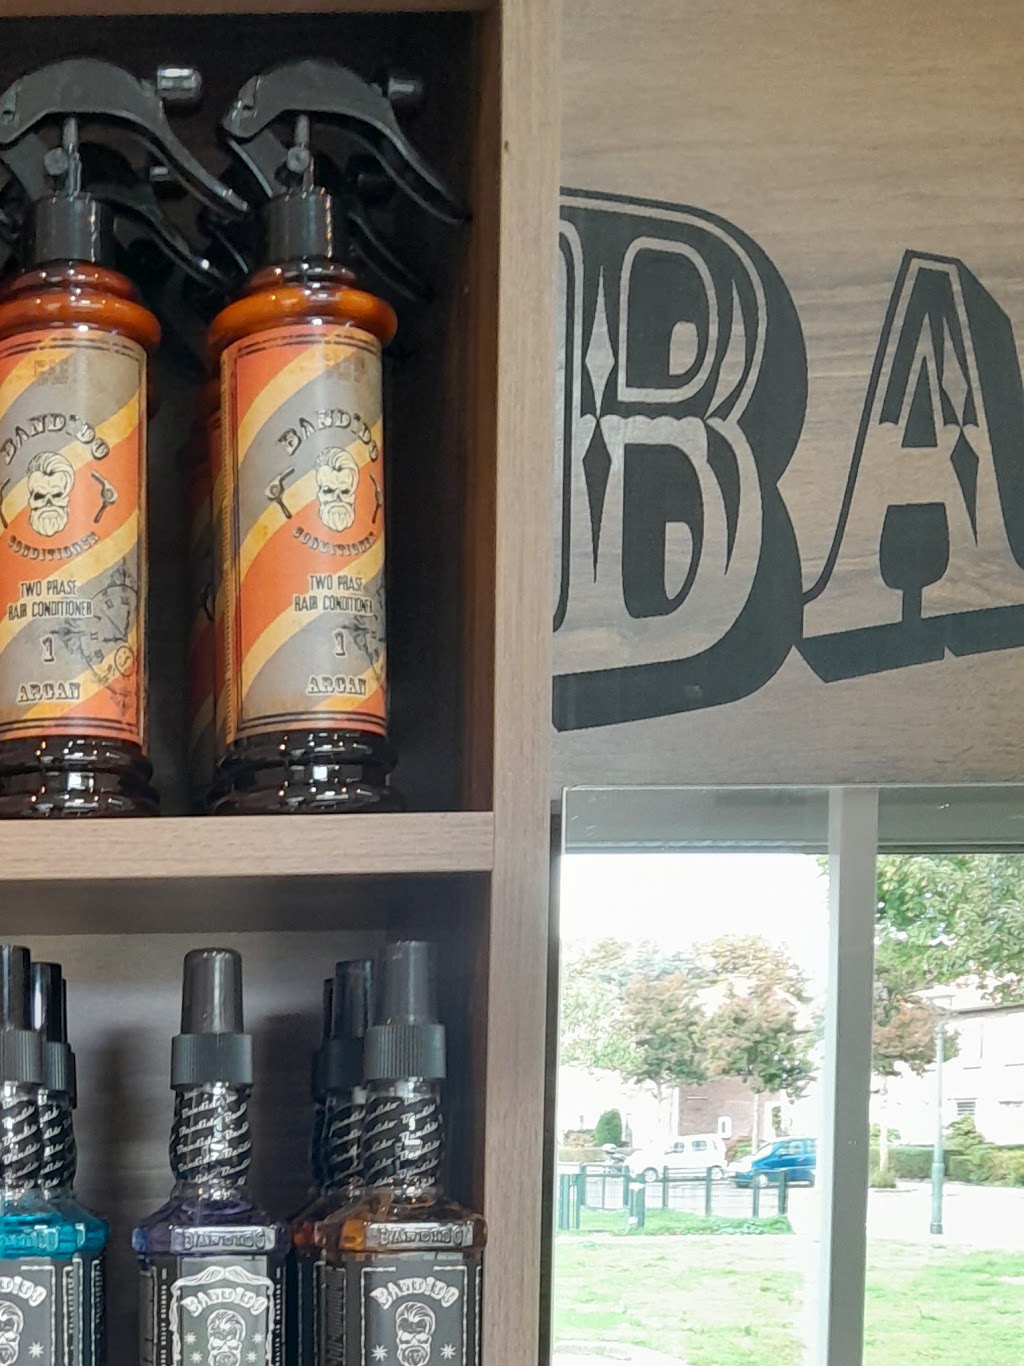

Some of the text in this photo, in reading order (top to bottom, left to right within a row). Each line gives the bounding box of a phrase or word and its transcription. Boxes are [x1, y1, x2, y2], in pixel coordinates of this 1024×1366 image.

[0, 413, 110, 465] BANDIDO
[21, 580, 76, 597] TWO PHASE
[310, 575, 363, 592] TWO PHASE
[32, 600, 92, 617] CONDITIONER
[42, 637, 54, 662] 1
[334, 631, 346, 656] 1
[18, 682, 81, 702] ARGAN
[307, 676, 367, 696] ARGAN
[180, 1287, 268, 1317] BANDIDO
[370, 1277, 459, 1310] BANDIDO
